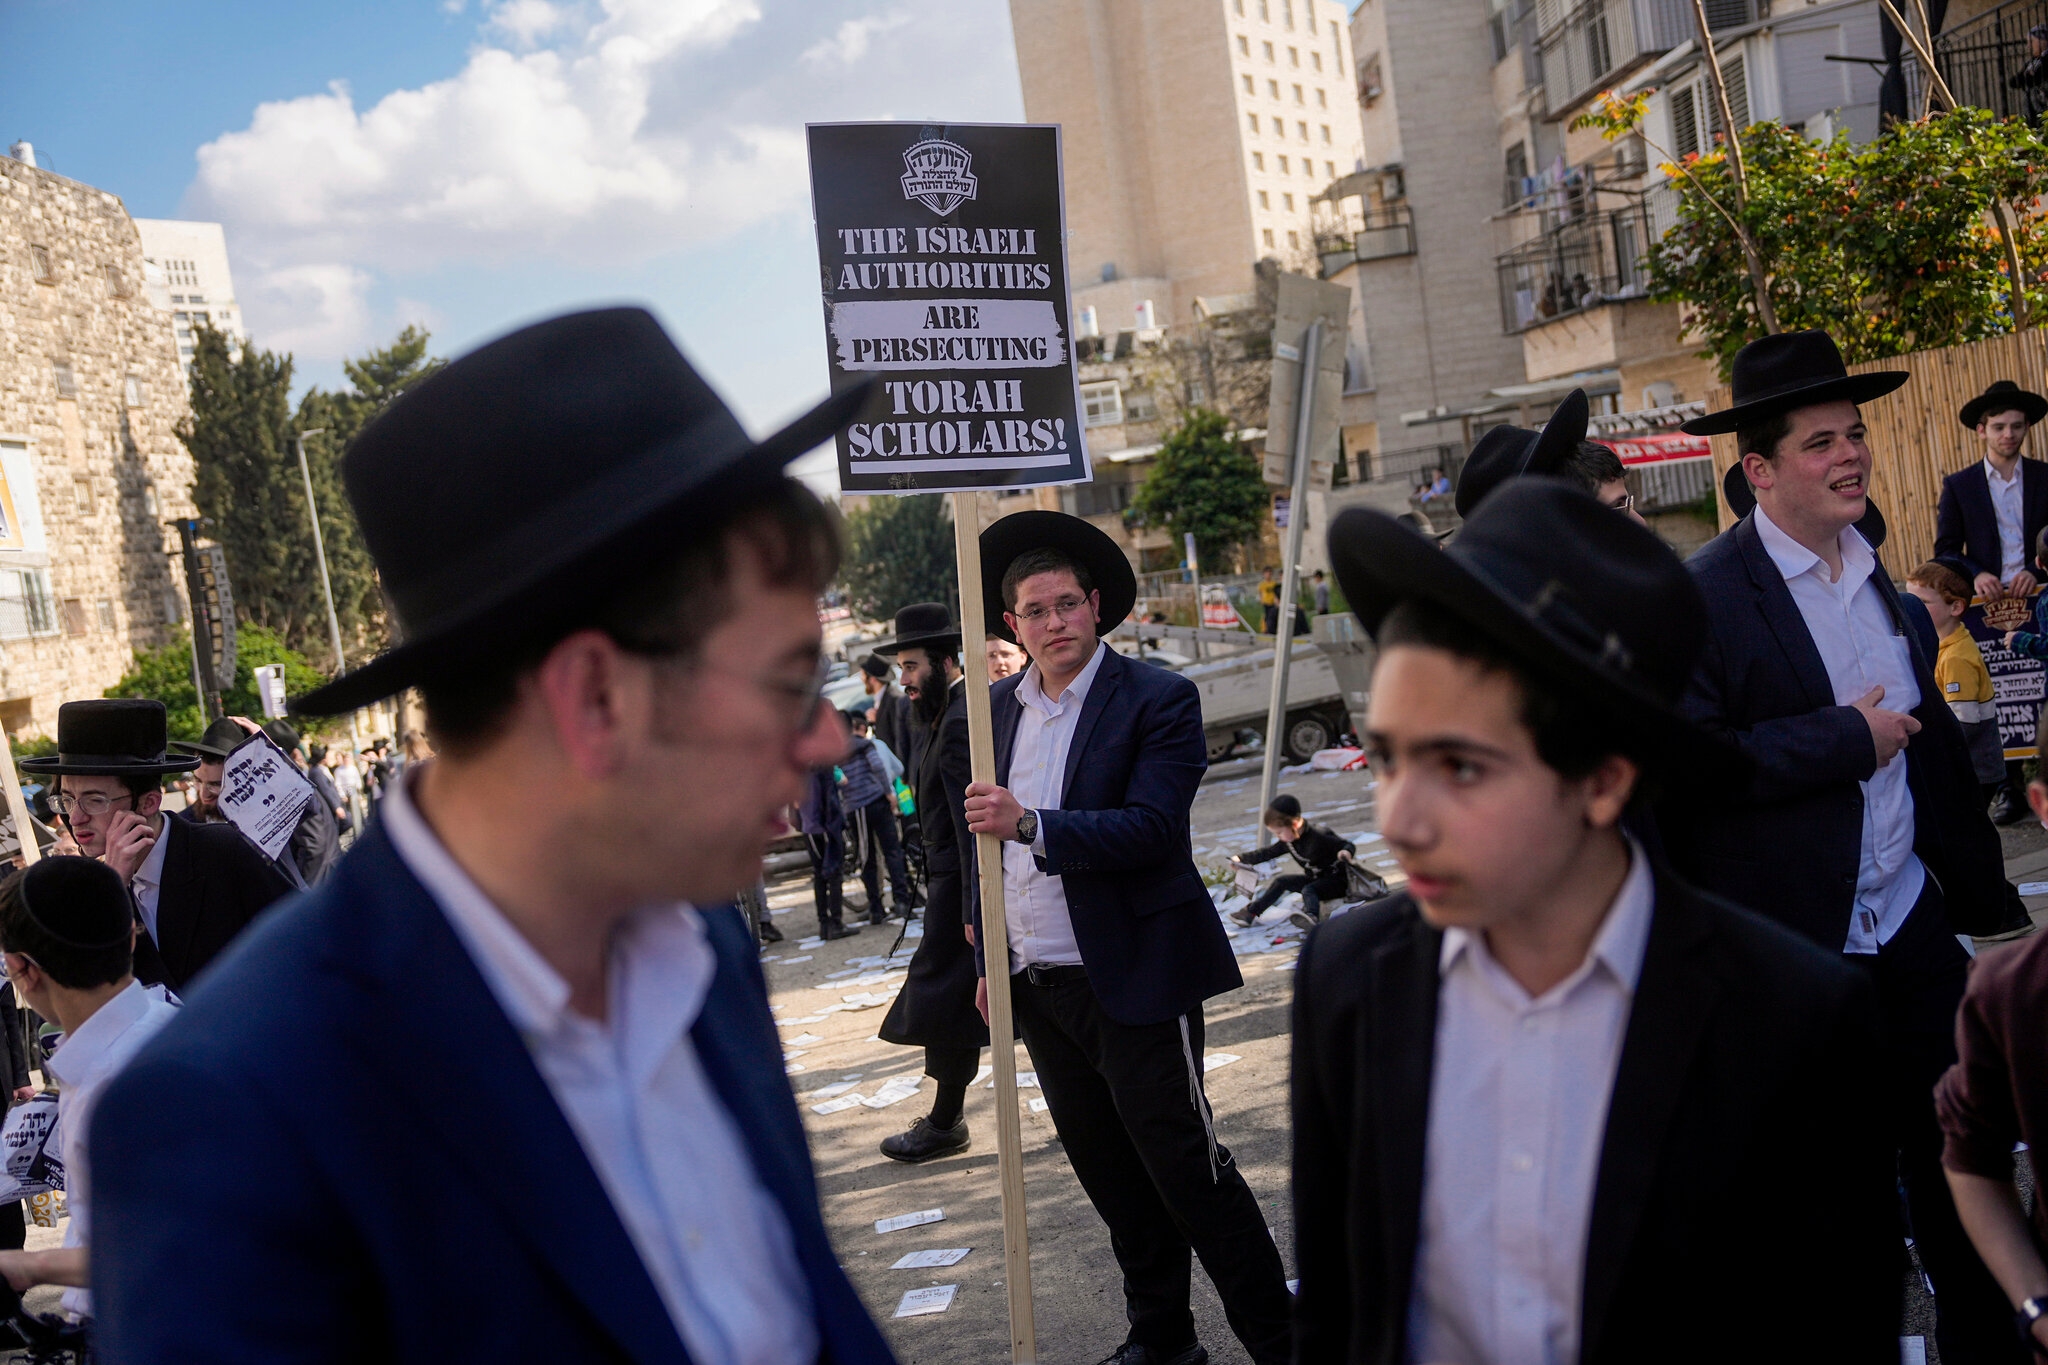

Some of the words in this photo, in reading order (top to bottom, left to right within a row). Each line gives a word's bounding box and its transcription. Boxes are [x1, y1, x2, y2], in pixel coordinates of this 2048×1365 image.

[921, 168, 958, 179] להצלת
[945, 179, 971, 192] עולם
[908, 180, 943, 193] התורה
[838, 228, 908, 255] THE
[915, 227, 1037, 255] ISRAELI
[837, 262, 1051, 290] AUTHORITIES
[922, 305, 980, 330] ARE
[852, 337, 1048, 363] PERSECUTING
[885, 380, 1024, 415] TORAH
[848, 418, 1068, 458] SCHOLARS!
[1989, 658, 2041, 673] מצהירים
[2031, 674, 2045, 685] לא
[252, 758, 280, 783] ואל
